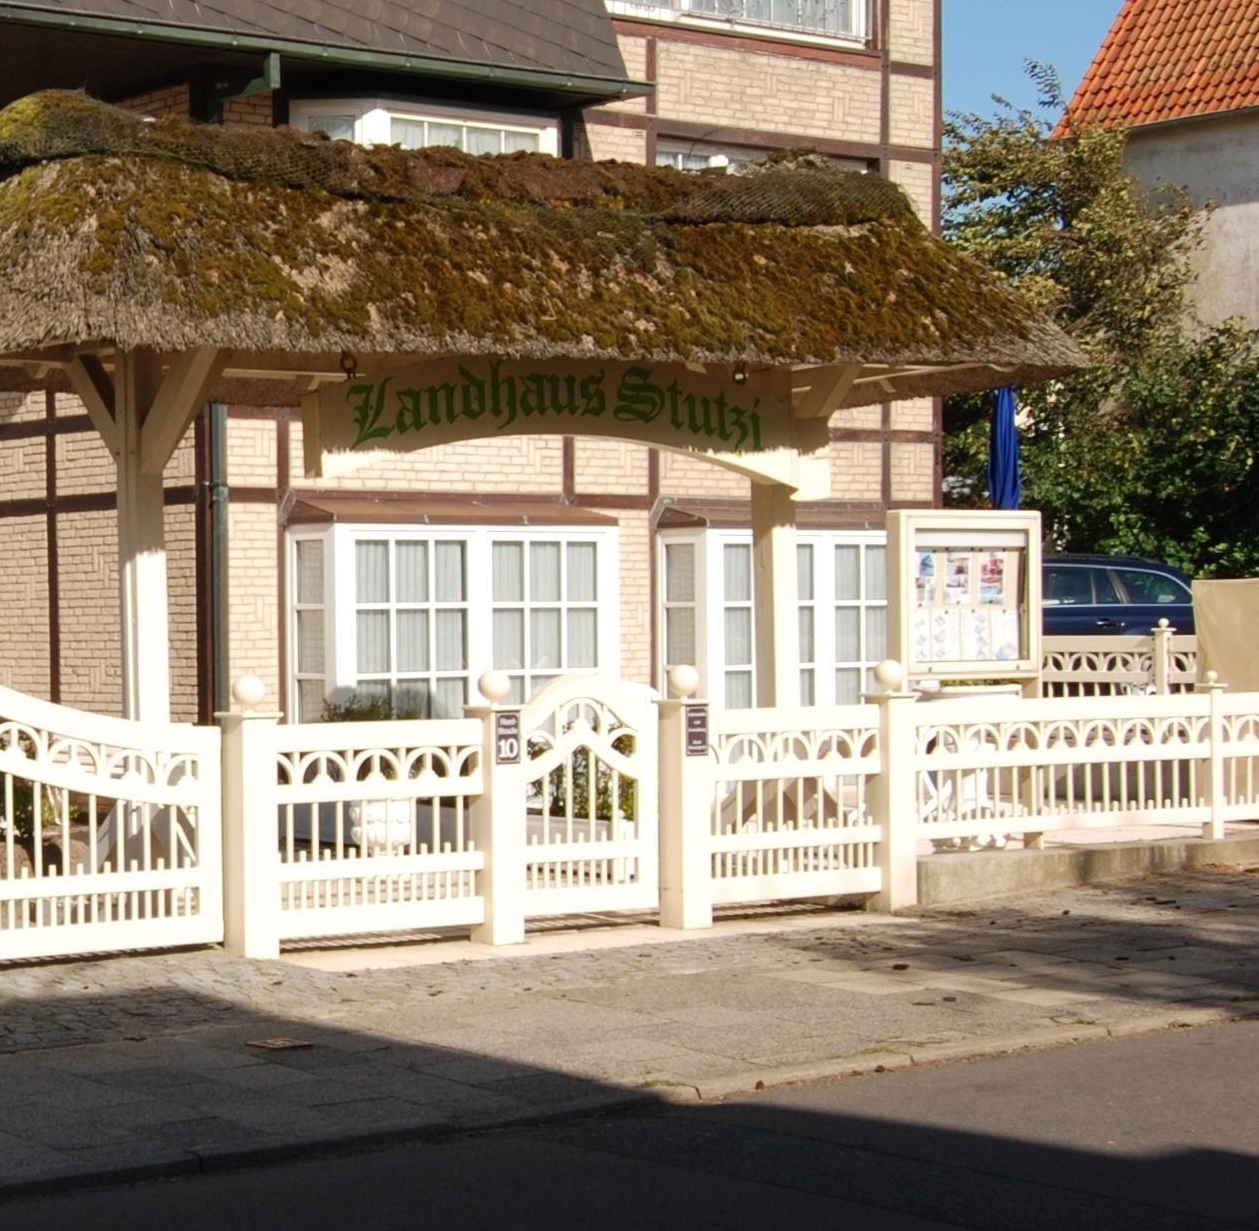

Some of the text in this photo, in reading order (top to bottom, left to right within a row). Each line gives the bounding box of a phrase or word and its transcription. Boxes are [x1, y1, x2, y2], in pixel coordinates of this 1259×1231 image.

[346, 358, 764, 456] Landhaus Stutzi
[498, 737, 519, 759] 10
